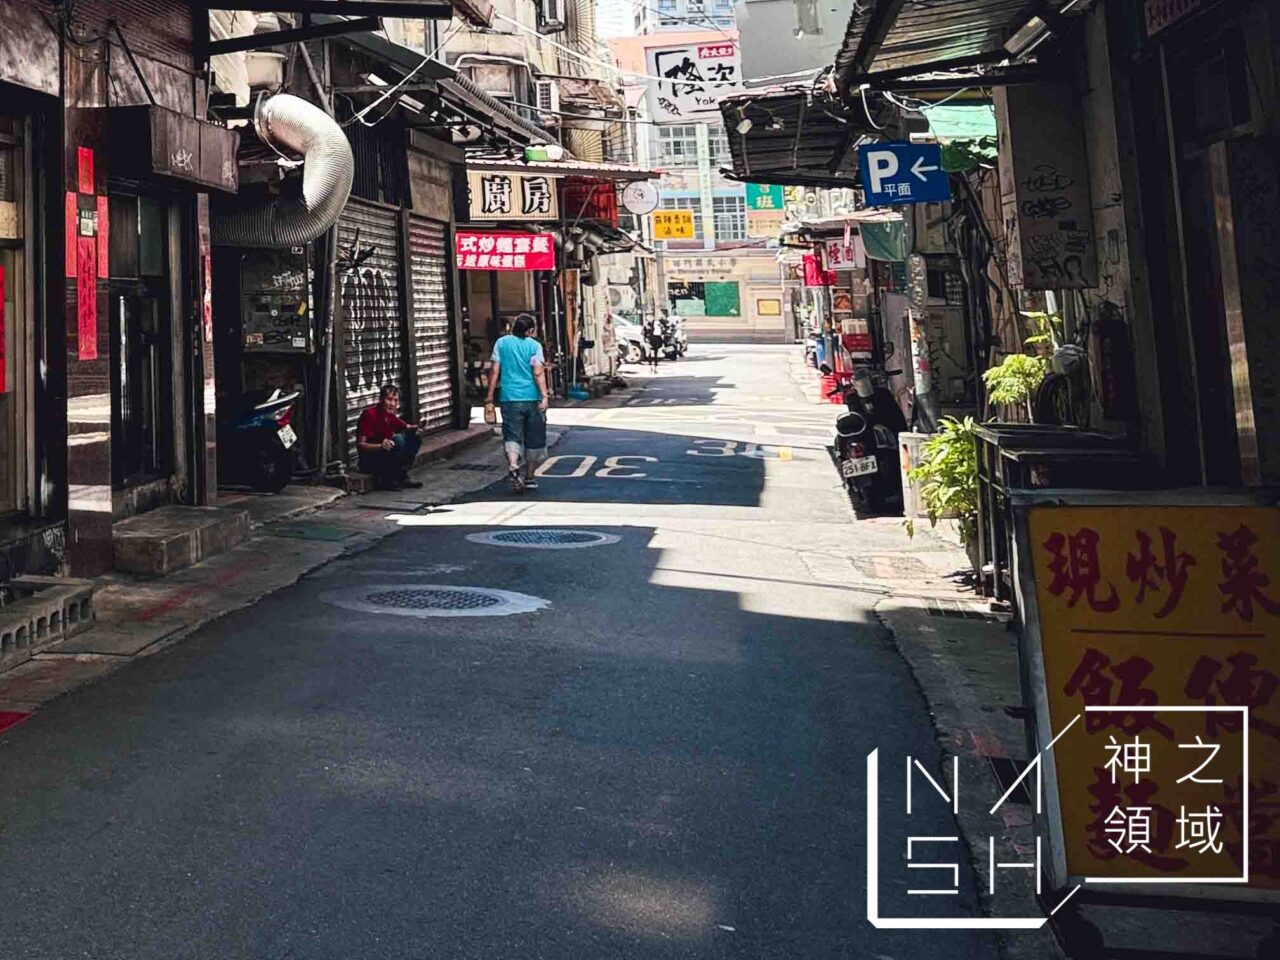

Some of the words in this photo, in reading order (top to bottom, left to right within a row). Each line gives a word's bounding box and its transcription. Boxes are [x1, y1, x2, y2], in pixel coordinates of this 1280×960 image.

[695, 96, 718, 106] Yak
[867, 150, 899, 194] P
[883, 183, 911, 197] 平面
[467, 174, 551, 214] 廚房
[1042, 524, 1280, 622] 現炒菜
